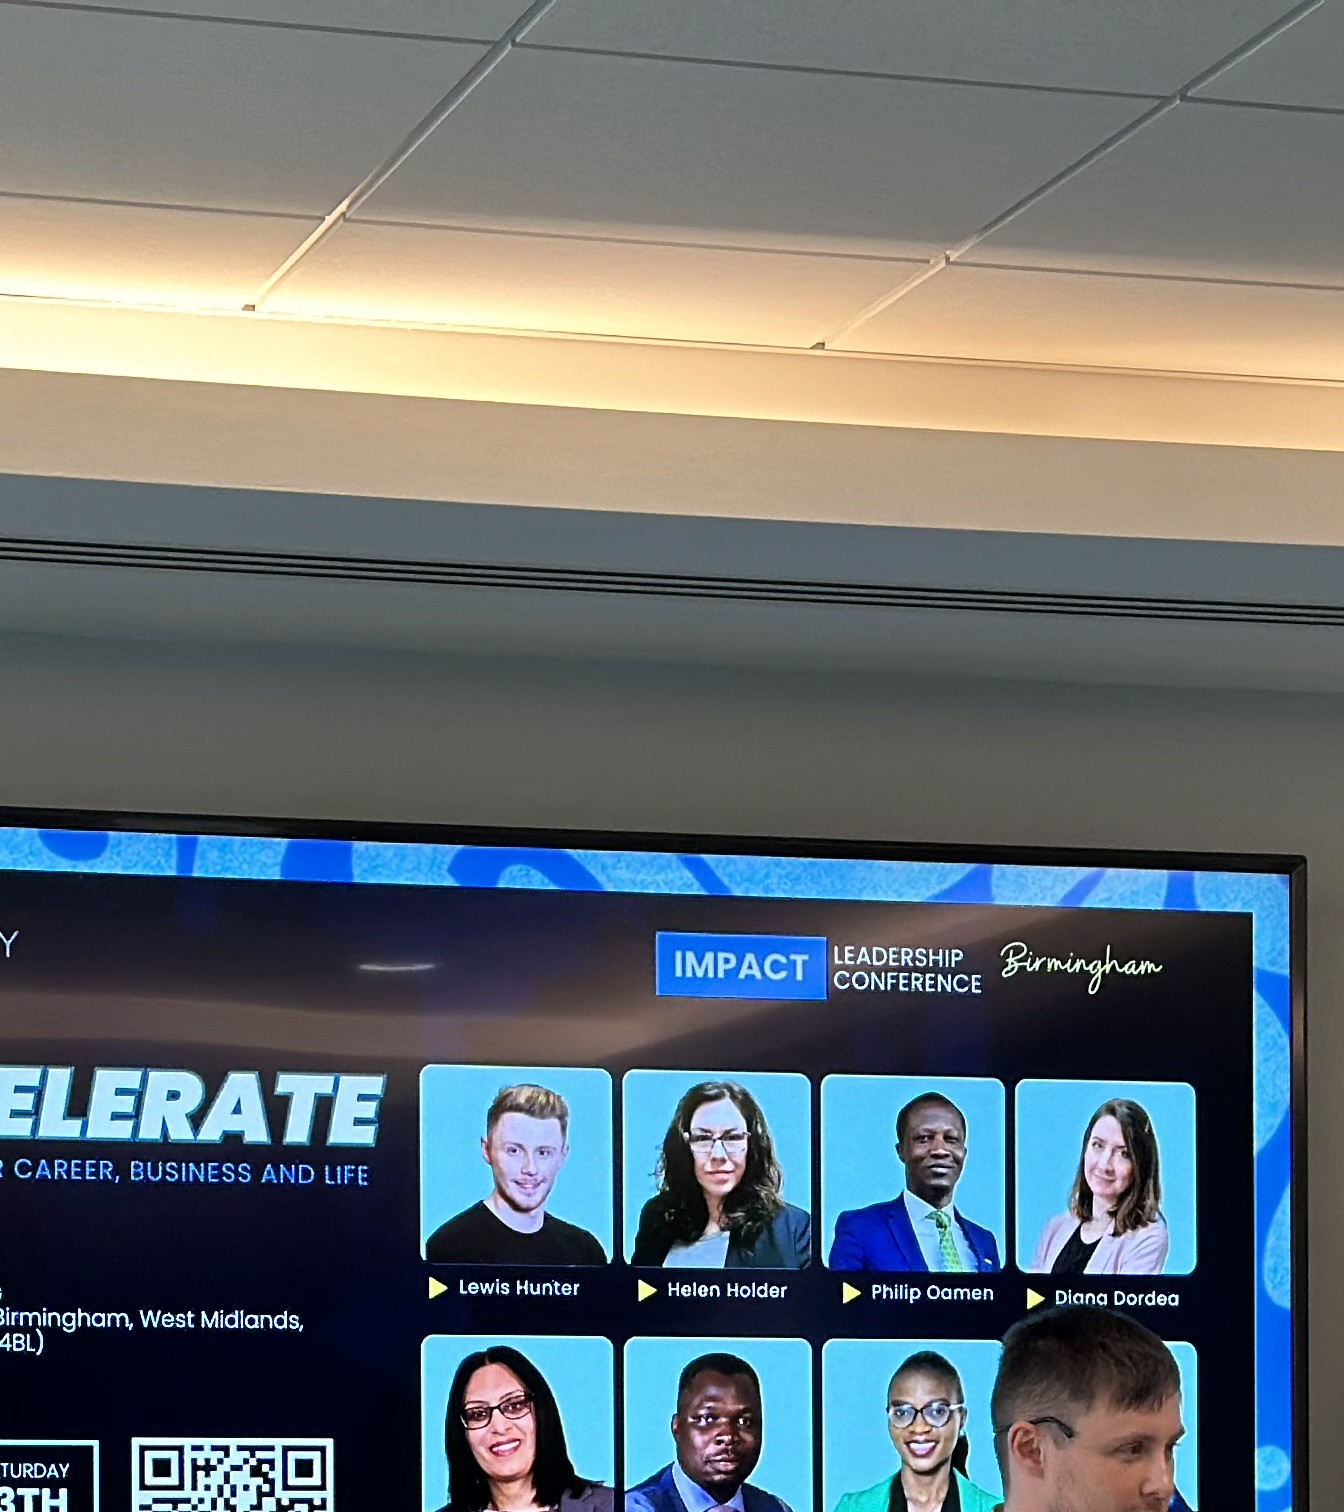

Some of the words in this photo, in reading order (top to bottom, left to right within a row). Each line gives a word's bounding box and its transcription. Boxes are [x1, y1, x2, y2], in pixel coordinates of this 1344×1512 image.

[676, 951, 809, 980] IMPACT
[834, 946, 964, 967] LEADERSHIP
[1000, 942, 1162, 994] Birmingham
[834, 971, 981, 993] CONFERENCE
[14, 1159, 119, 1183] CAREER,
[131, 1161, 251, 1182] BUSINESS
[261, 1164, 314, 1183] AND
[325, 1165, 368, 1185] LIFE
[460, 1279, 509, 1295] Lewis
[517, 1280, 579, 1295] Hunter
[668, 1282, 720, 1297] Helen
[727, 1282, 787, 1298] Holder
[872, 1284, 921, 1303] Philip
[927, 1285, 993, 1300] Oamen
[1056, 1289, 1107, 1305] Diana
[1114, 1291, 1179, 1306] Dordea
[140, 1310, 195, 1328] West
[201, 1310, 303, 1332] Midlands,
